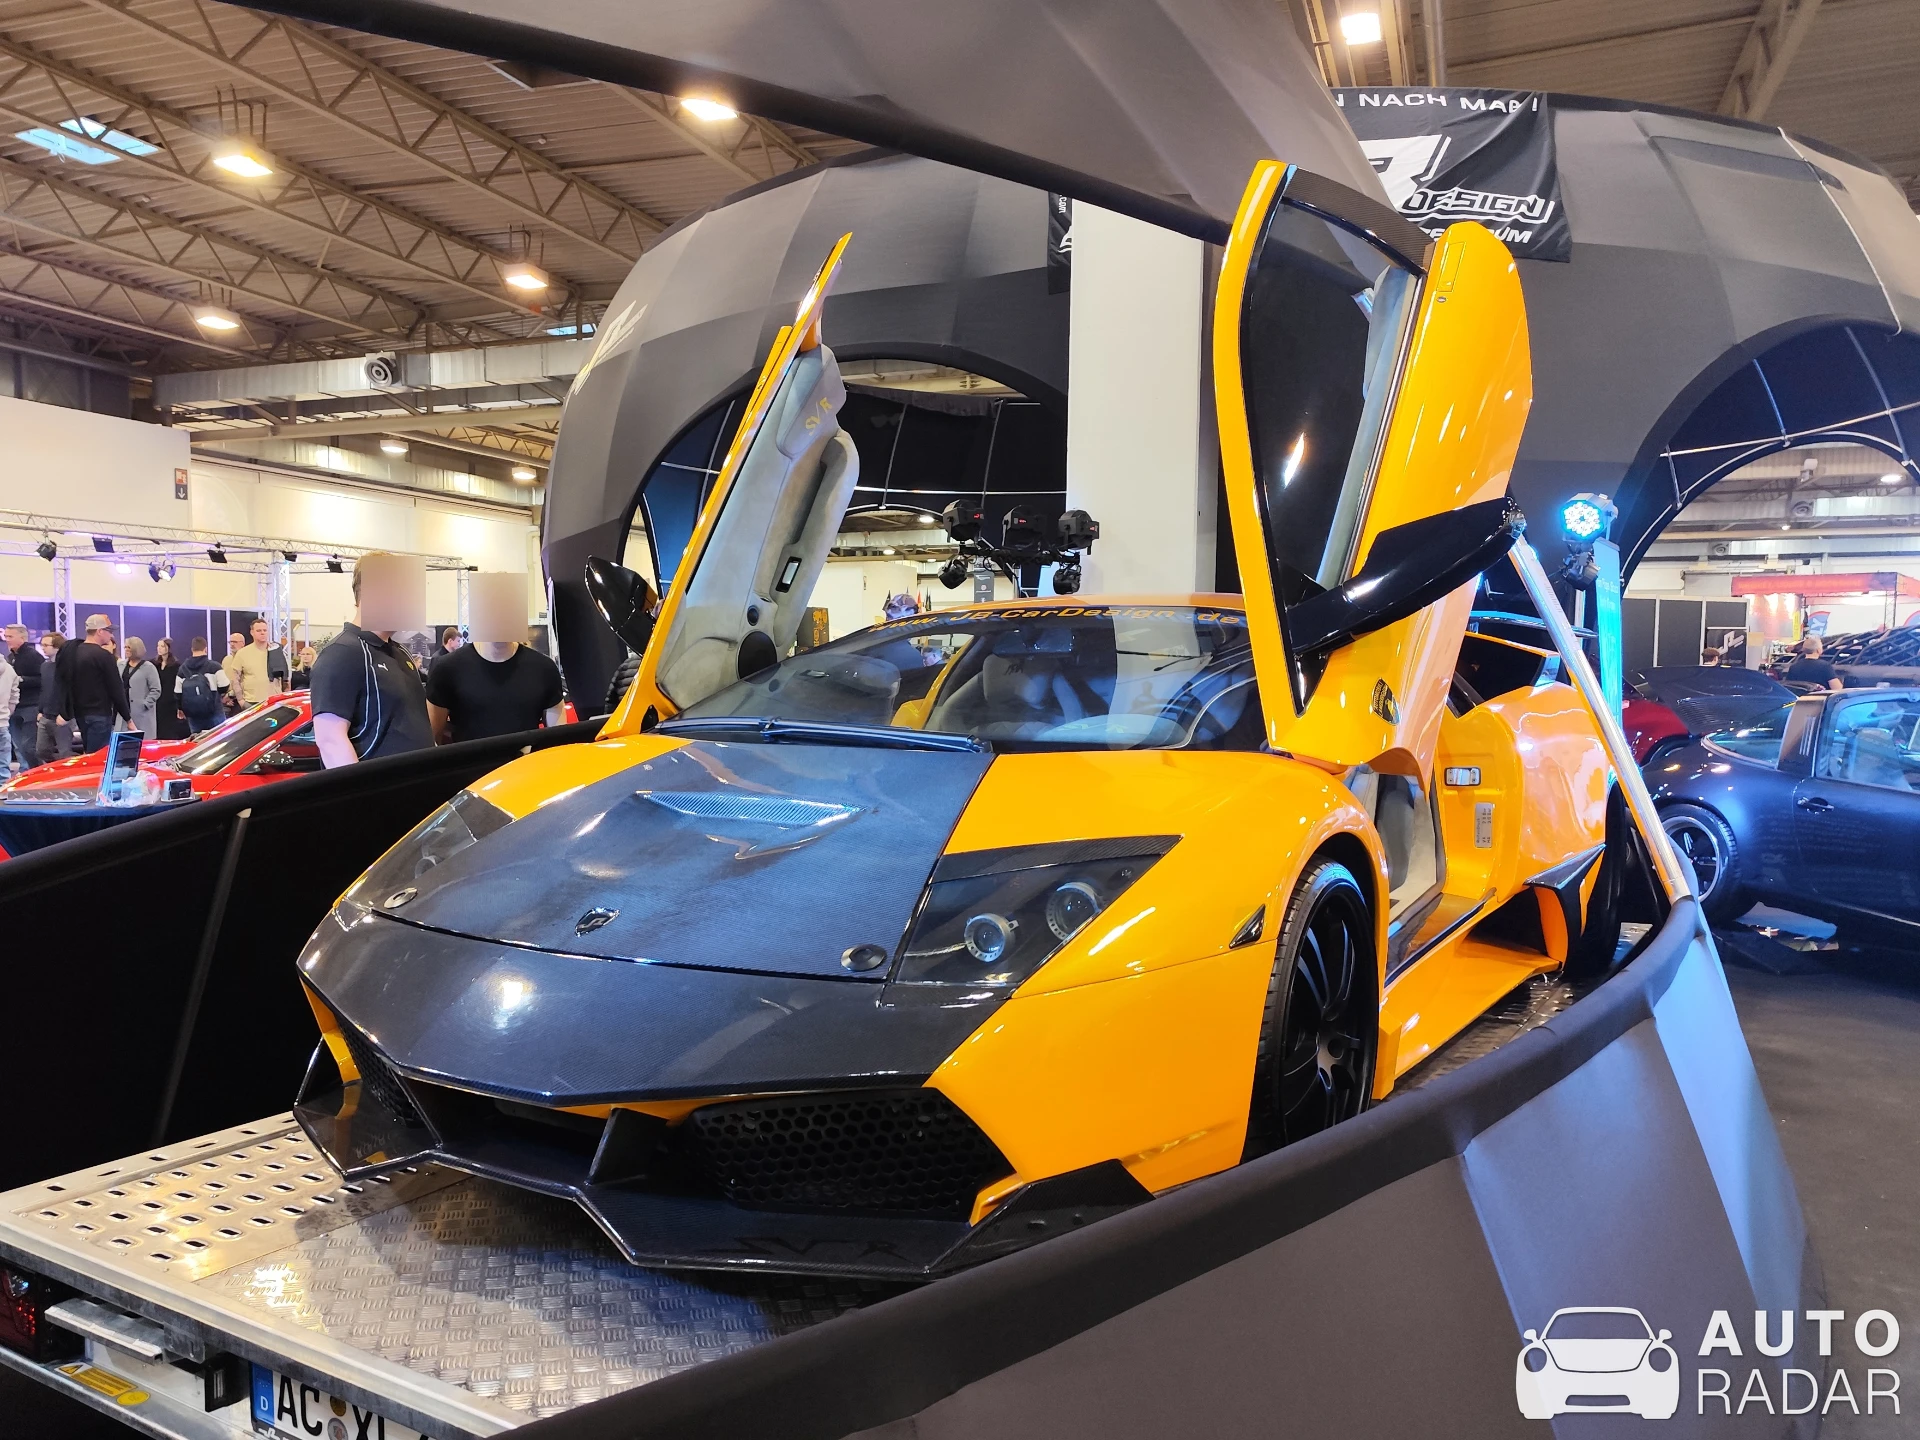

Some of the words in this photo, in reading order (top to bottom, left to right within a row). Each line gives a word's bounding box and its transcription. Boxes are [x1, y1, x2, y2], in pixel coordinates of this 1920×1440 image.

[1359, 93, 1447, 107] NACH
[1402, 190, 1546, 218] DESIGN
[260, 1395, 269, 1412] D
[277, 1374, 323, 1437] AC
